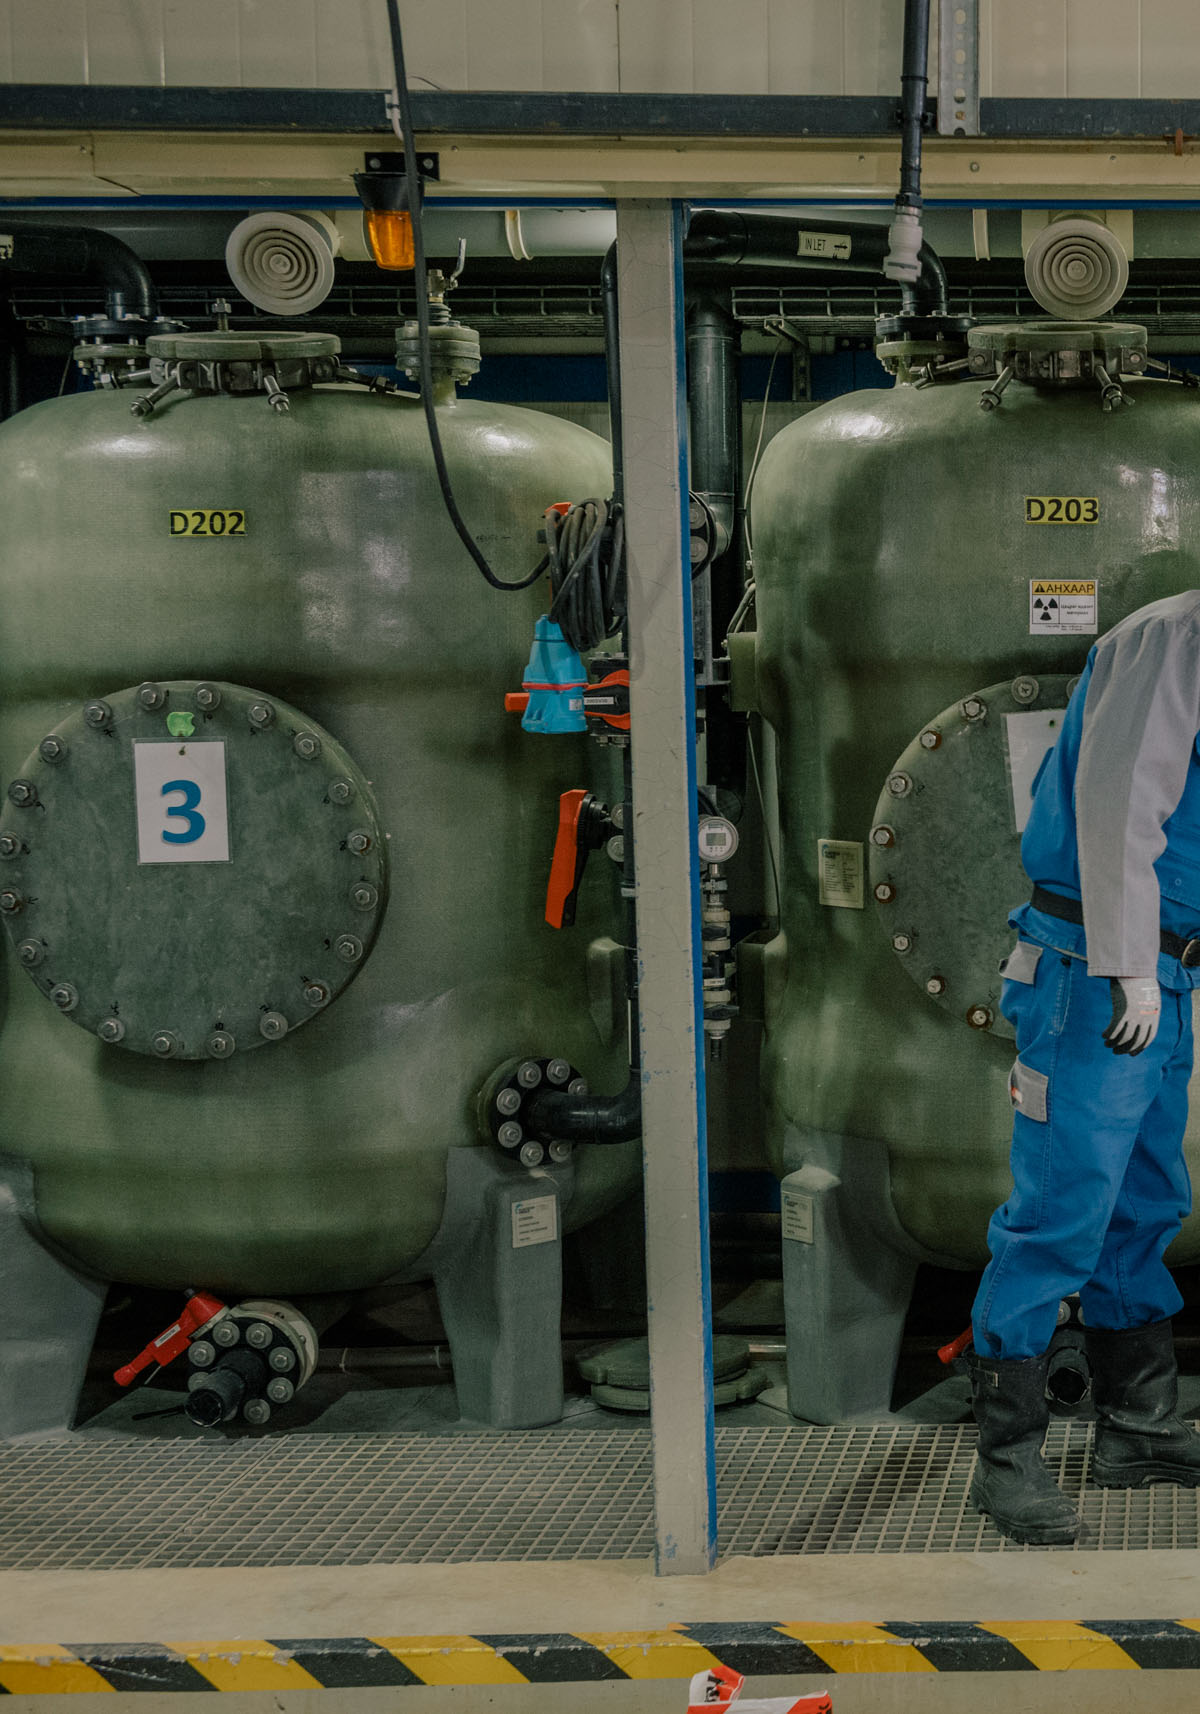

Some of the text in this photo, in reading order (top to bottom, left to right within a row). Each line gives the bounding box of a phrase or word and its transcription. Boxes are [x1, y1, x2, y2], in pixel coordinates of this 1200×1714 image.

[805, 238, 826, 251] INLET
[1026, 498, 1099, 522] D203
[170, 511, 246, 535] D202
[1046, 583, 1095, 594] АНХААР
[161, 779, 206, 844] 3
